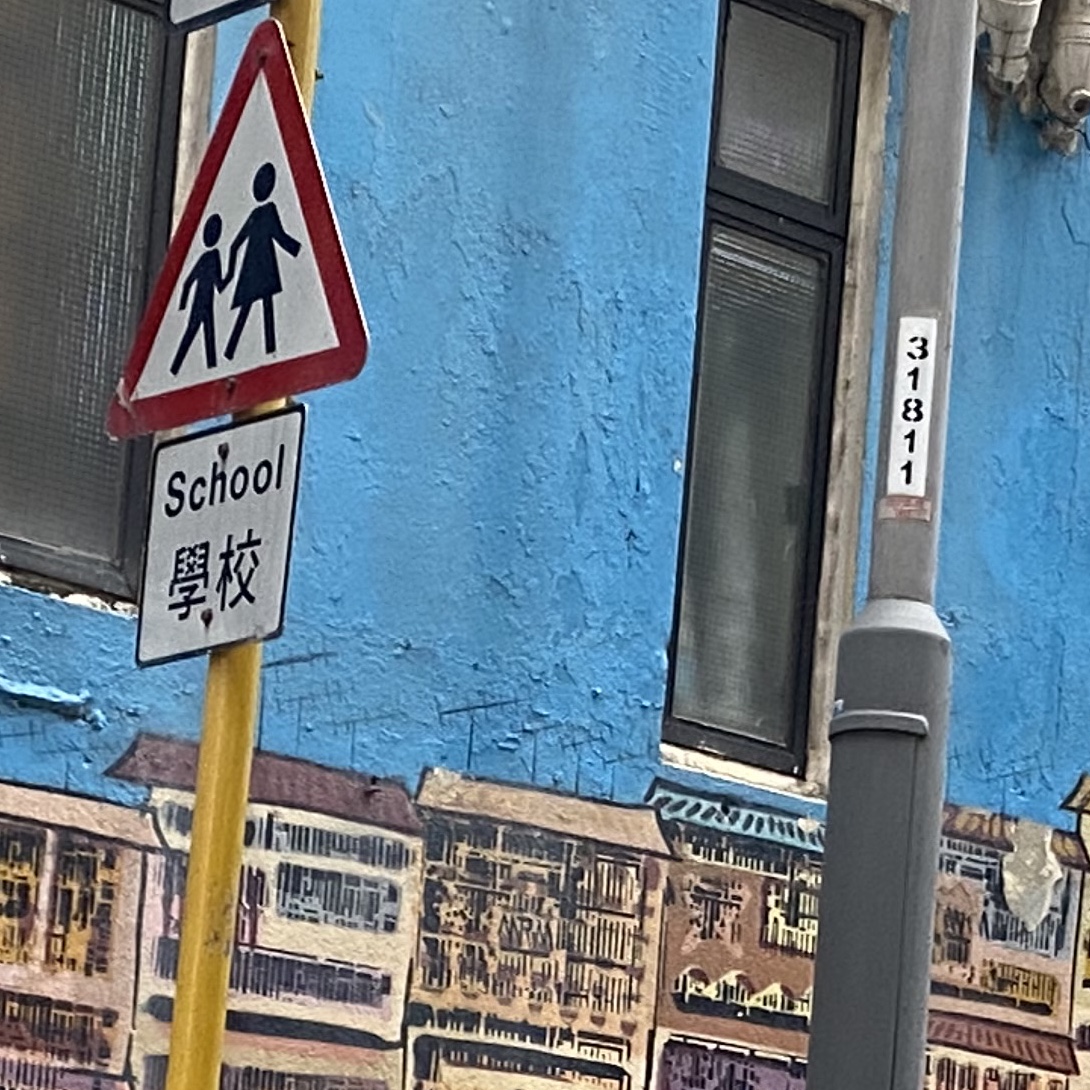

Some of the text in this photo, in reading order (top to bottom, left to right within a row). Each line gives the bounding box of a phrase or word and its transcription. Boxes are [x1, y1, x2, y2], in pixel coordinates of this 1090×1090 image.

[900, 336, 929, 485] 31811
[164, 443, 285, 518] School
[168, 528, 262, 621] 學校
